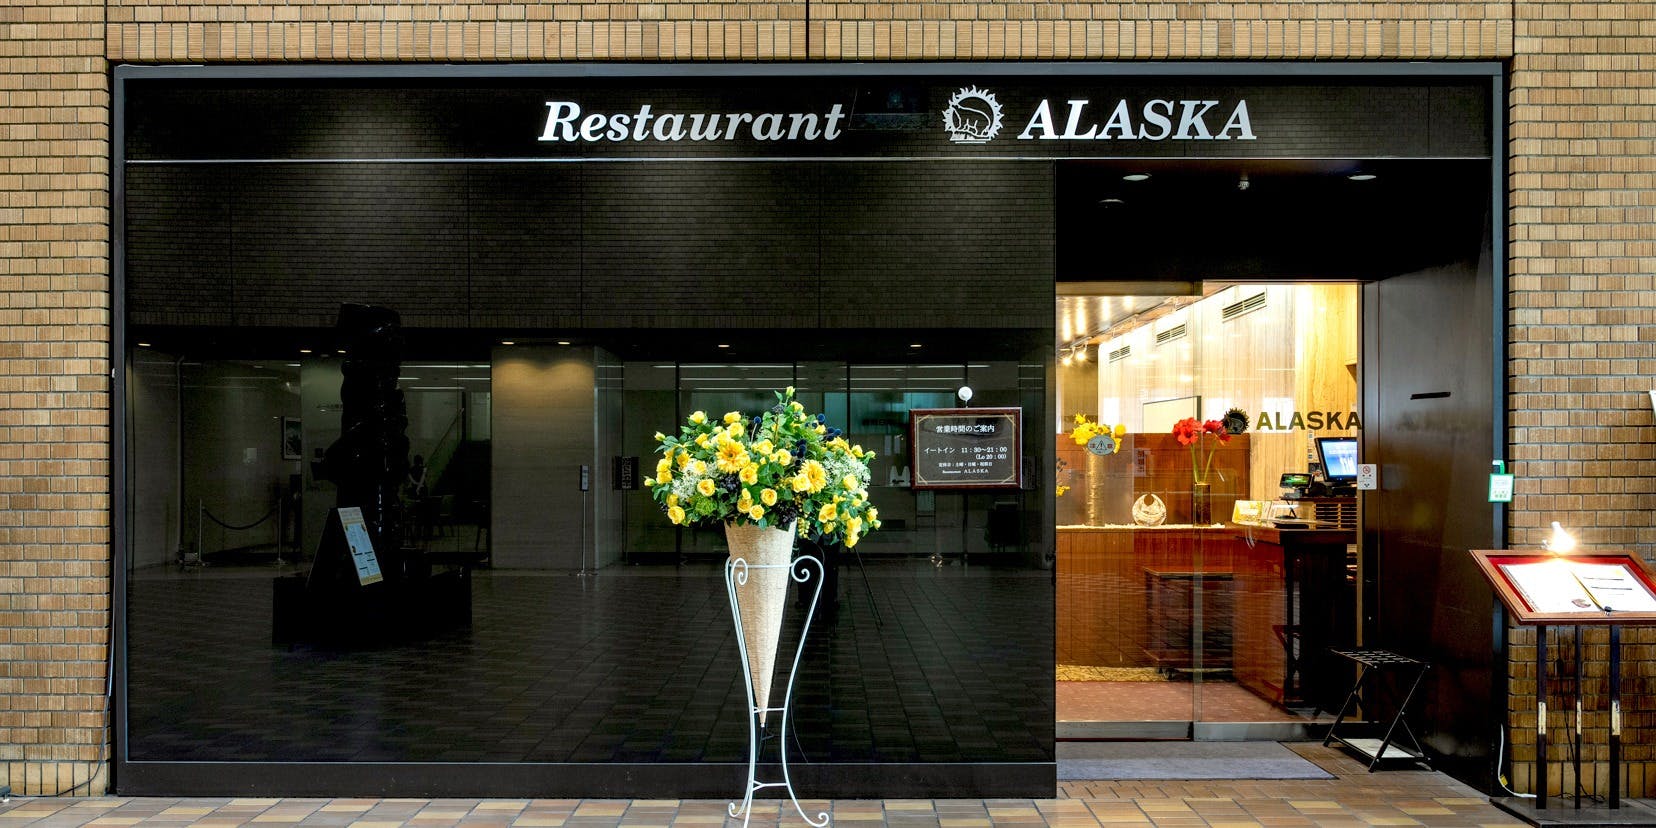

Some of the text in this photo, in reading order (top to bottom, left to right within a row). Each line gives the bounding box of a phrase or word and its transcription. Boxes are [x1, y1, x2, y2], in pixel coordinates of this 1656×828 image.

[538, 99, 1257, 142] Restaurant ALASKA
[1256, 411, 1362, 431] ALASKA
[935, 424, 995, 434] 営業時間のご案内
[924, 446, 956, 455] イートイン
